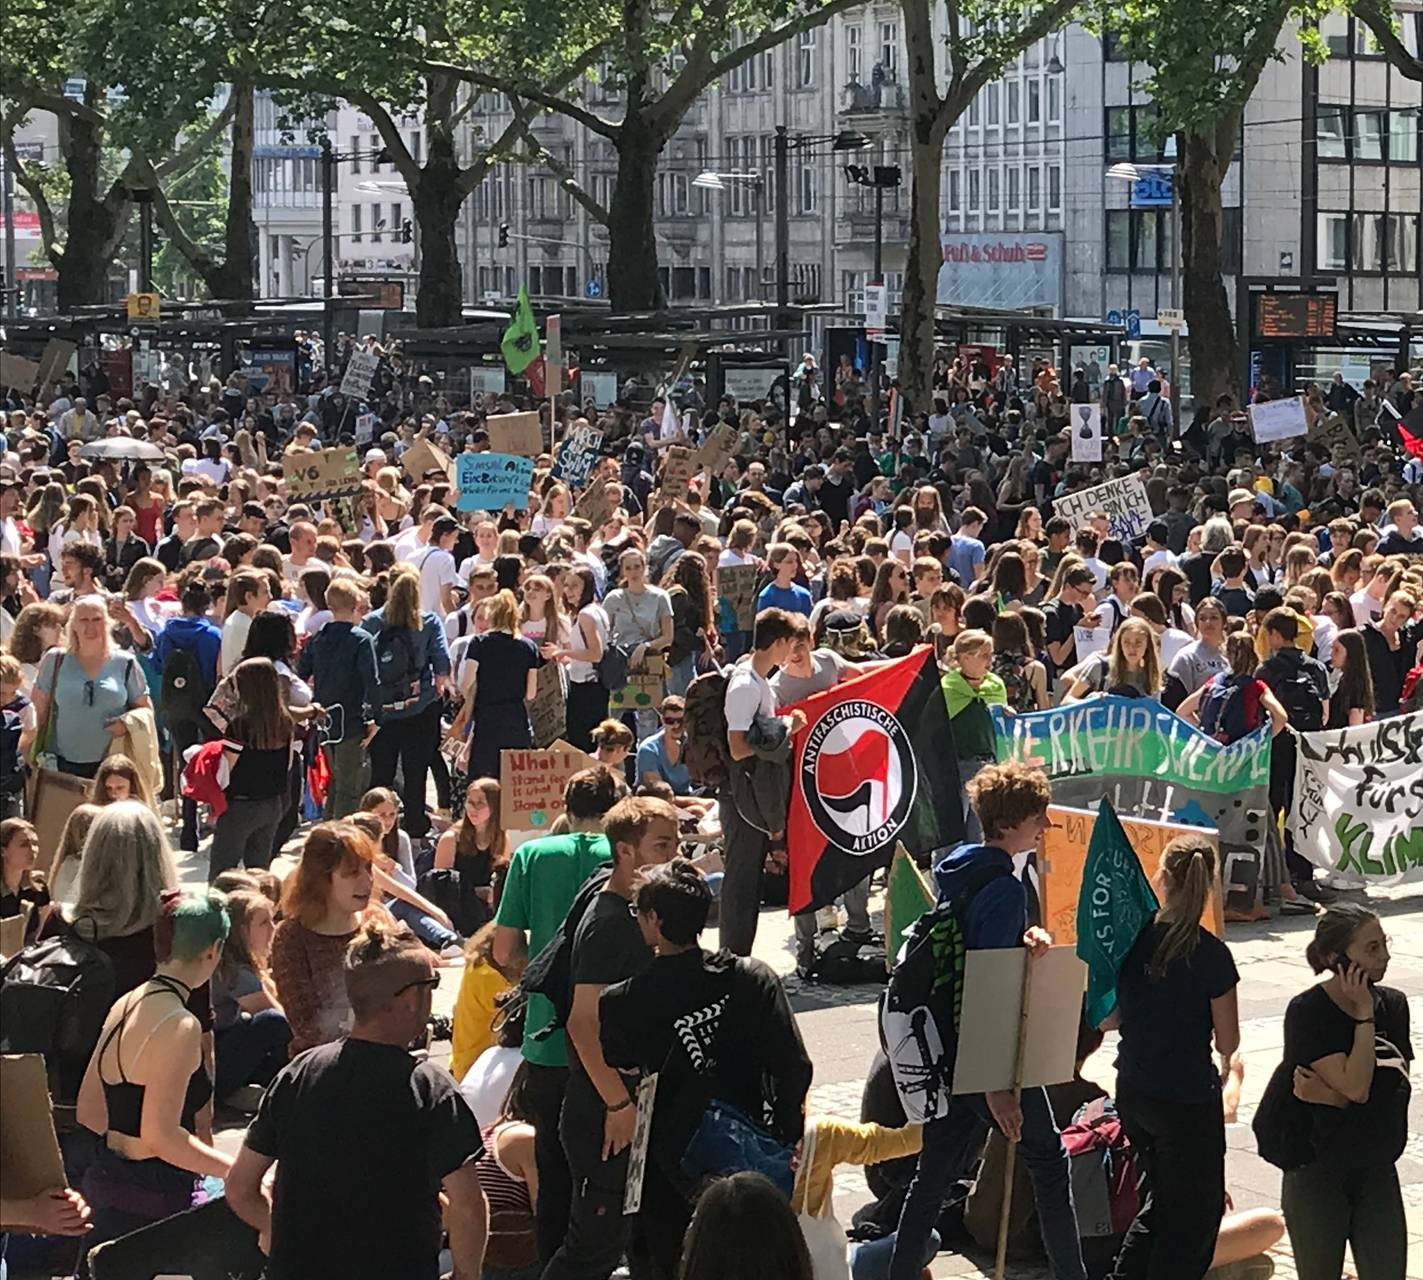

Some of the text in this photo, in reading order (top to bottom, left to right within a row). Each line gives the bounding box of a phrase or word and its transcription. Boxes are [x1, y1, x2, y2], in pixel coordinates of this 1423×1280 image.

[1056, 478, 1134, 517] ICH DENKE
[803, 702, 900, 775] ANTIFASCHISTISCHE
[508, 751, 571, 772] What I
[852, 817, 898, 851] AKTION
[1092, 872, 1112, 919] FOR
